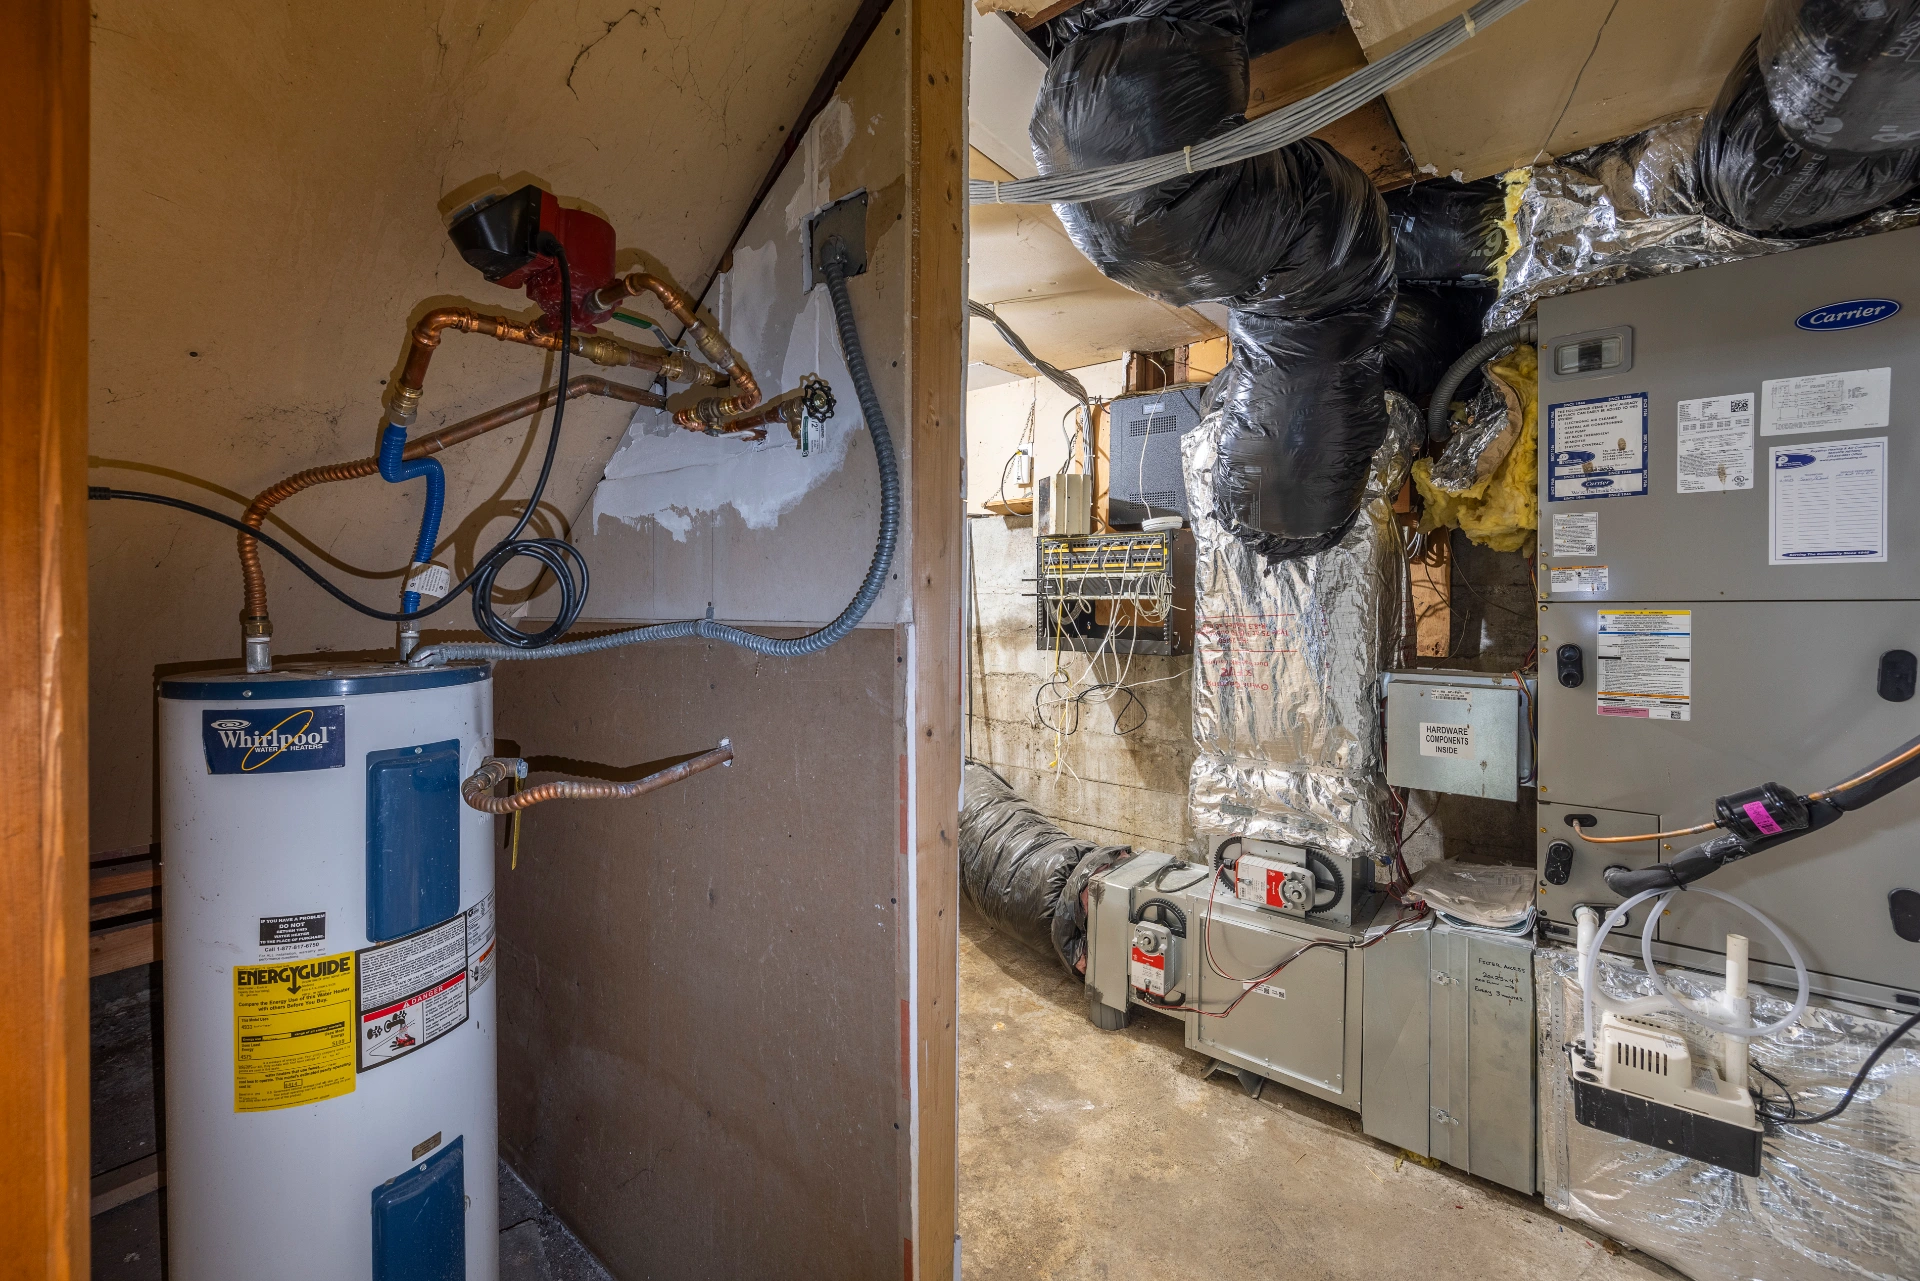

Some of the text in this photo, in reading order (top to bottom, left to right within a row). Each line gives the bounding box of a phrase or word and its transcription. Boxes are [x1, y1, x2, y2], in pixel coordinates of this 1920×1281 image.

[1819, 65, 1858, 109] FLEX
[1775, 176, 1808, 205] FLEXIBLE
[1809, 305, 1886, 324] Carrier
[218, 727, 329, 751] Whirlpool
[1426, 726, 1469, 736] HARDWARE
[1426, 735, 1469, 745] COMPONENTS
[290, 743, 323, 751] HEATERS
[1435, 746, 1458, 754] INSIDE
[237, 956, 351, 989] ENERGYGUIDE
[411, 985, 444, 1005] DANGER
